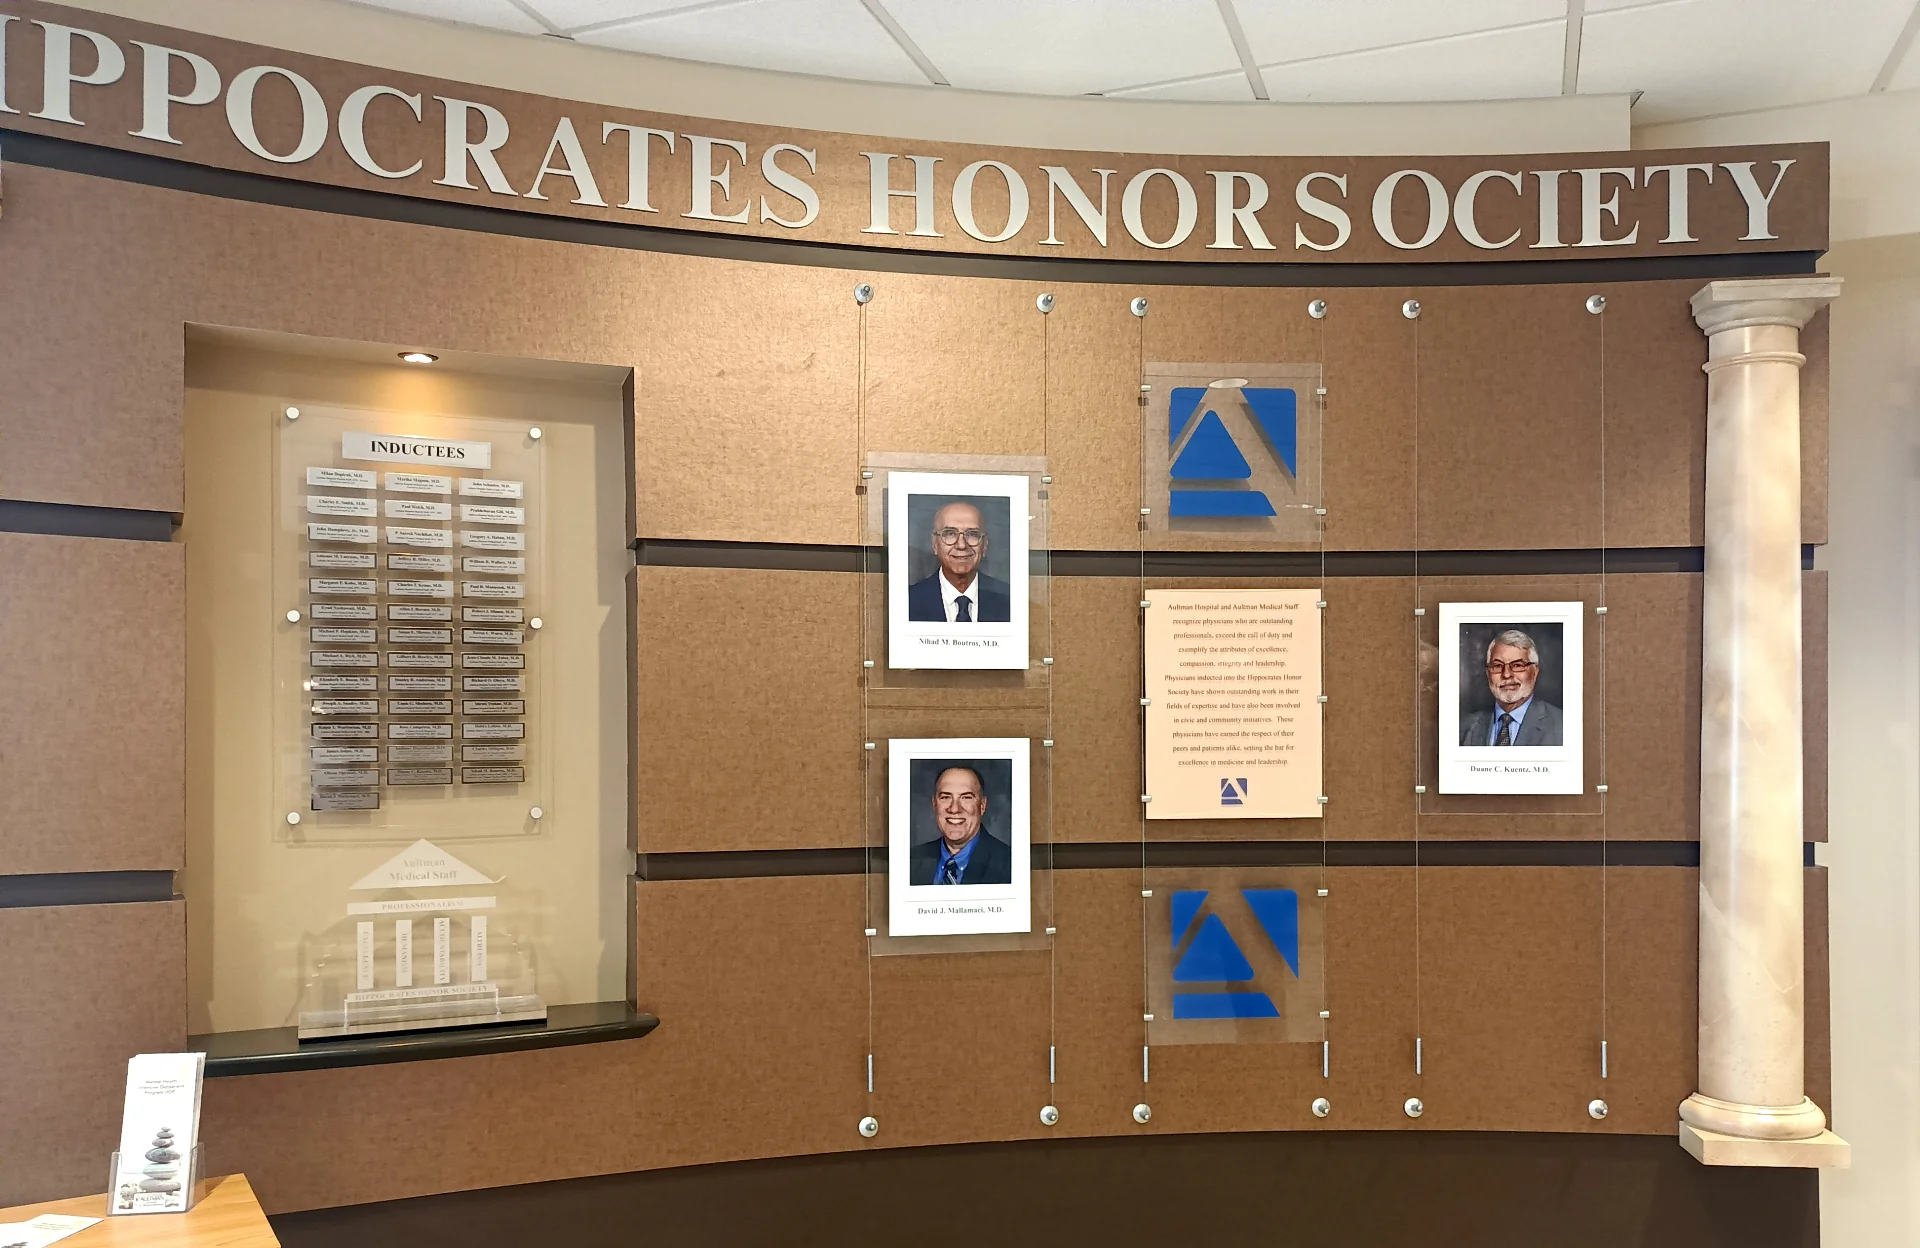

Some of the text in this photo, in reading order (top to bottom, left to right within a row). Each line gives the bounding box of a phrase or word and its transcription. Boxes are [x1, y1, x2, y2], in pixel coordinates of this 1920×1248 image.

[860, 150, 1276, 253] HONOR
[1294, 158, 1796, 252] SOCIETY
[371, 440, 465, 460] INDUCTEES
[1203, 618, 1233, 627] physicians
[1174, 632, 1214, 641] professionals,
[1216, 632, 1235, 640] exceed
[1248, 632, 1258, 640] call
[1267, 632, 1280, 640] duty
[952, 639, 981, 647] Boutros,
[1179, 646, 1208, 655] exemplify
[1248, 646, 1255, 654] of
[1255, 660, 1286, 668] leadership.
[1165, 675, 1195, 683] Physicians
[1248, 674, 1281, 682] Hippocrates
[1173, 731, 1203, 739] physicians
[1220, 731, 1239, 739] earned
[1275, 744, 1284, 752] bar
[1179, 759, 1209, 767] excellence
[1218, 759, 1244, 768] medicine
[1470, 765, 1493, 773] Duane
[1494, 765, 1502, 773] C.
[1504, 765, 1531, 773] Kuentz,
[404, 859, 445, 868] Aultman
[390, 870, 458, 881] Medical Staff
[918, 907, 938, 915] David
[948, 906, 986, 914] Mallamaci,
